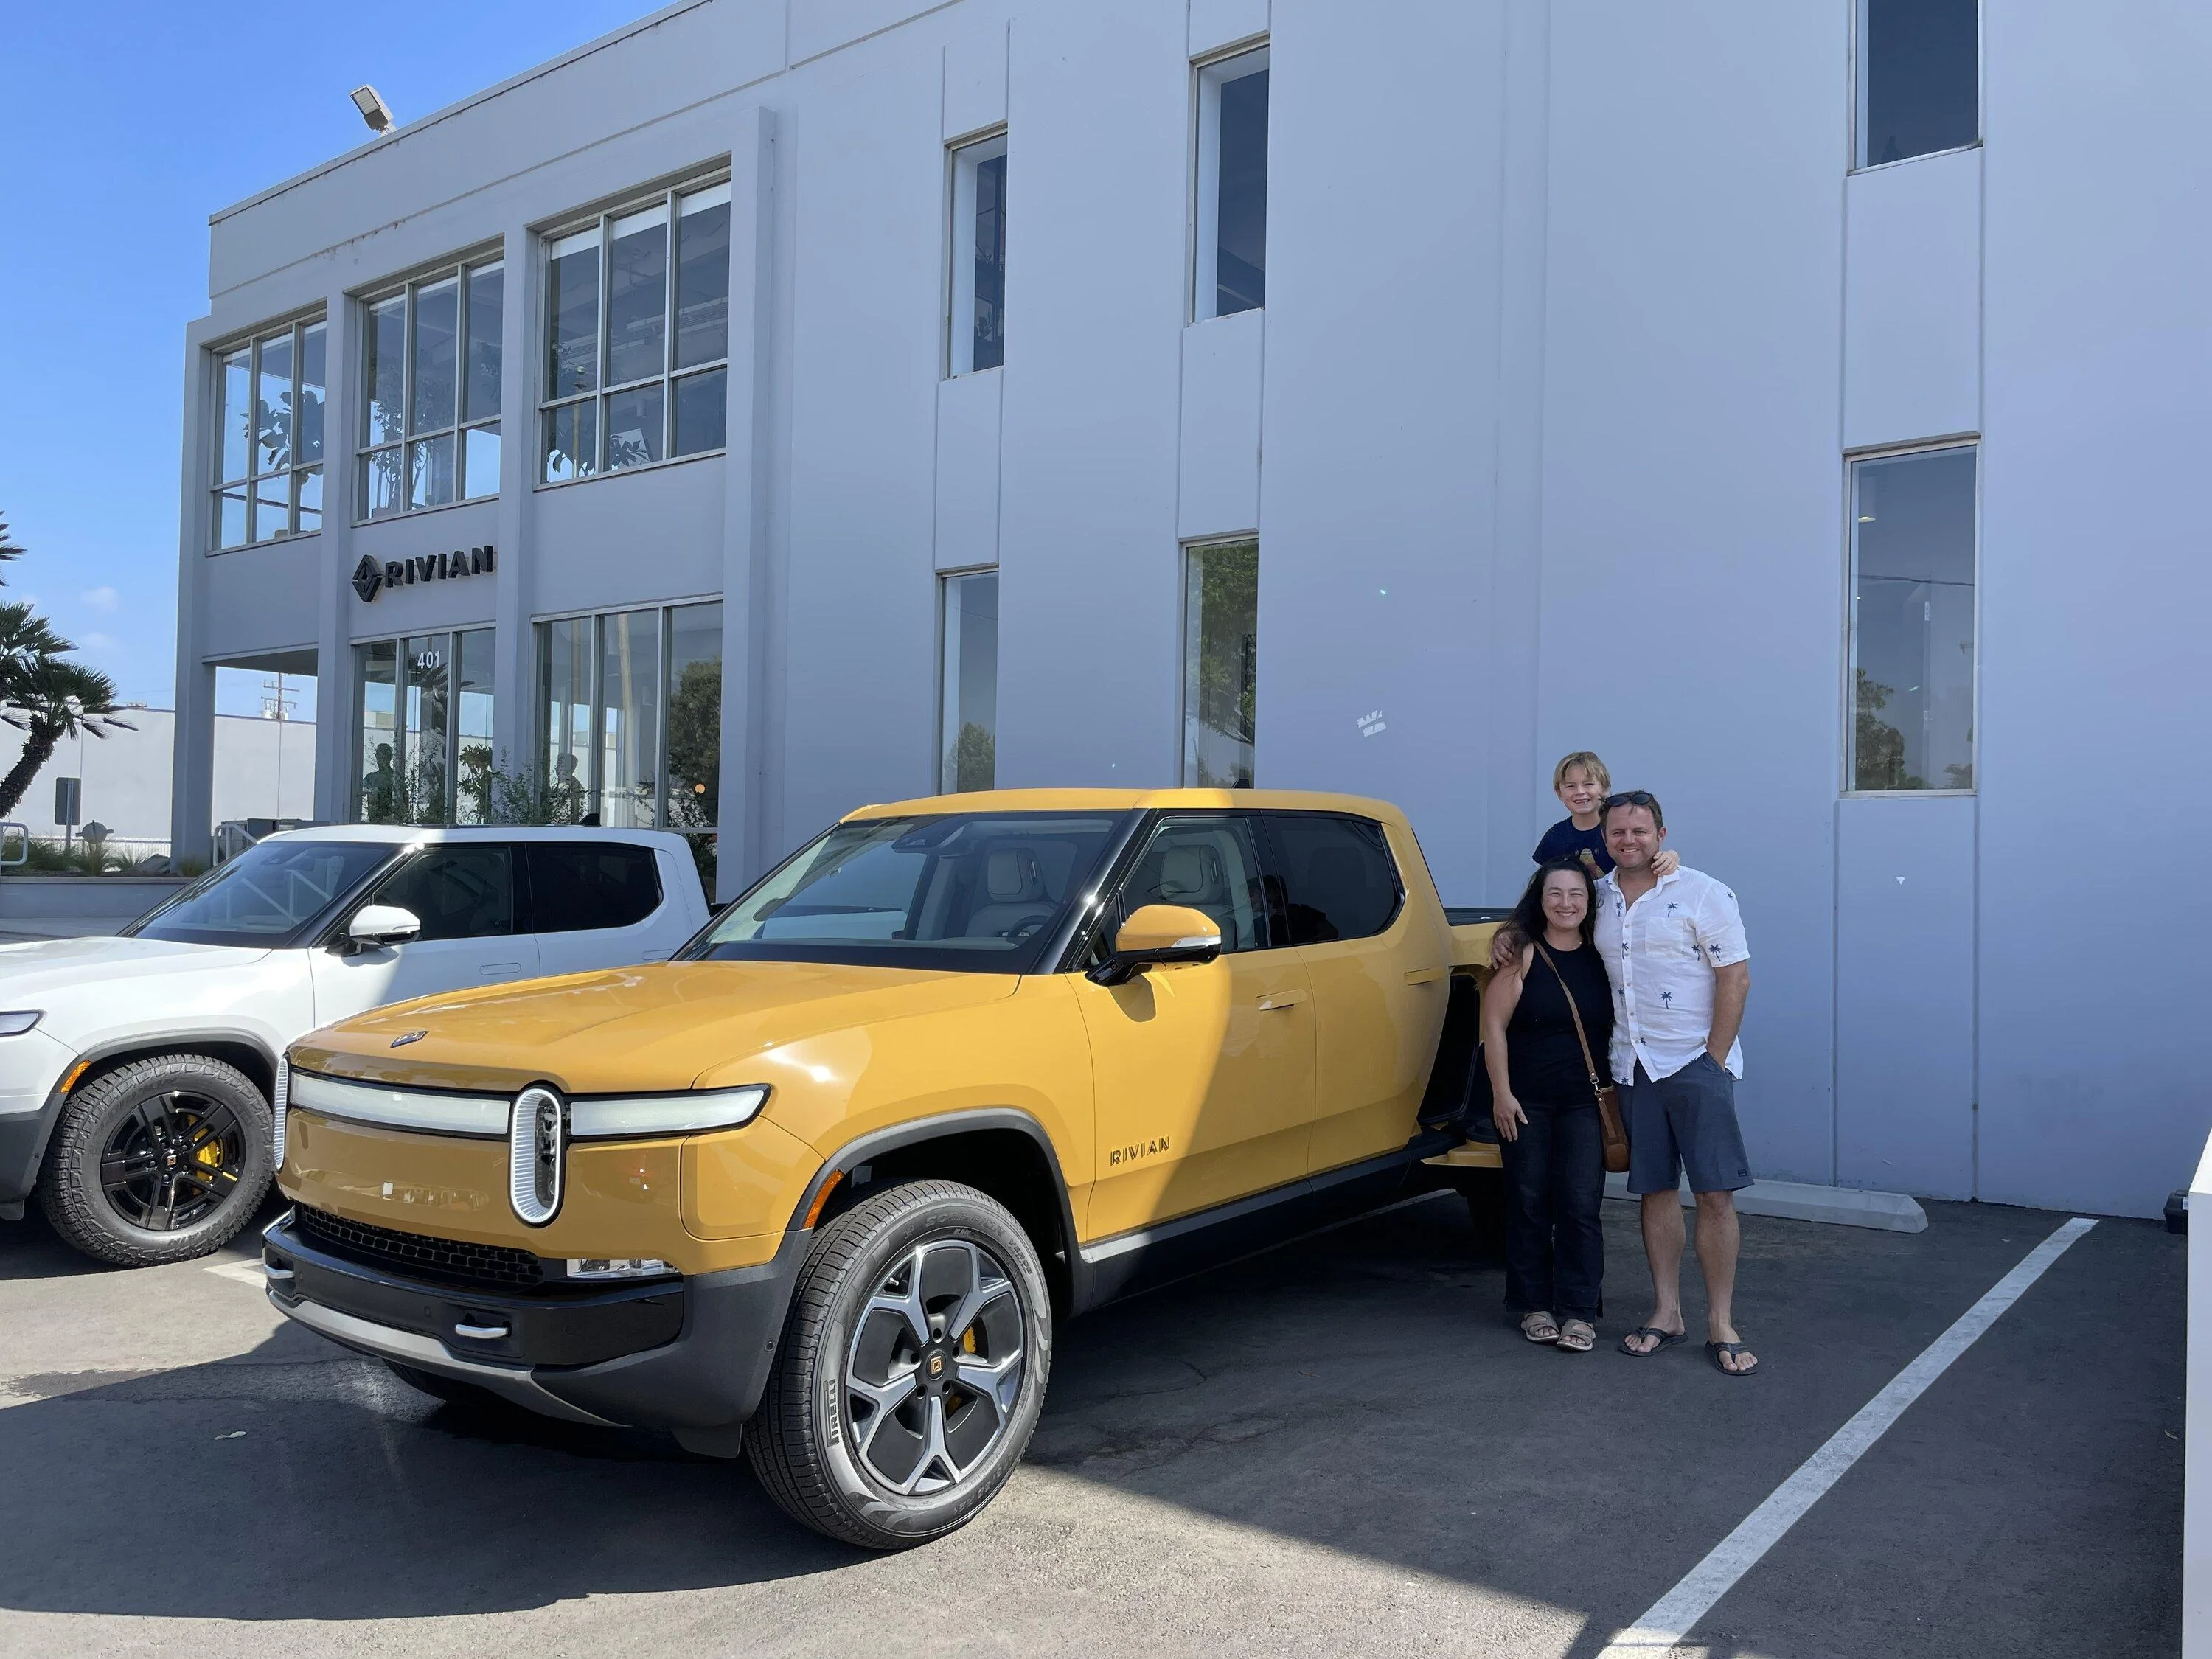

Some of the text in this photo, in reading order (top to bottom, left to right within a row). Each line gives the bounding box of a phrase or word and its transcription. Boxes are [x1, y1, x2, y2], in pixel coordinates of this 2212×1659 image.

[385, 546, 493, 588] RIVIAN
[417, 650, 440, 669] 401
[1110, 1135, 1170, 1167] RIVIAN
[823, 1379, 840, 1447] PIRELLI
